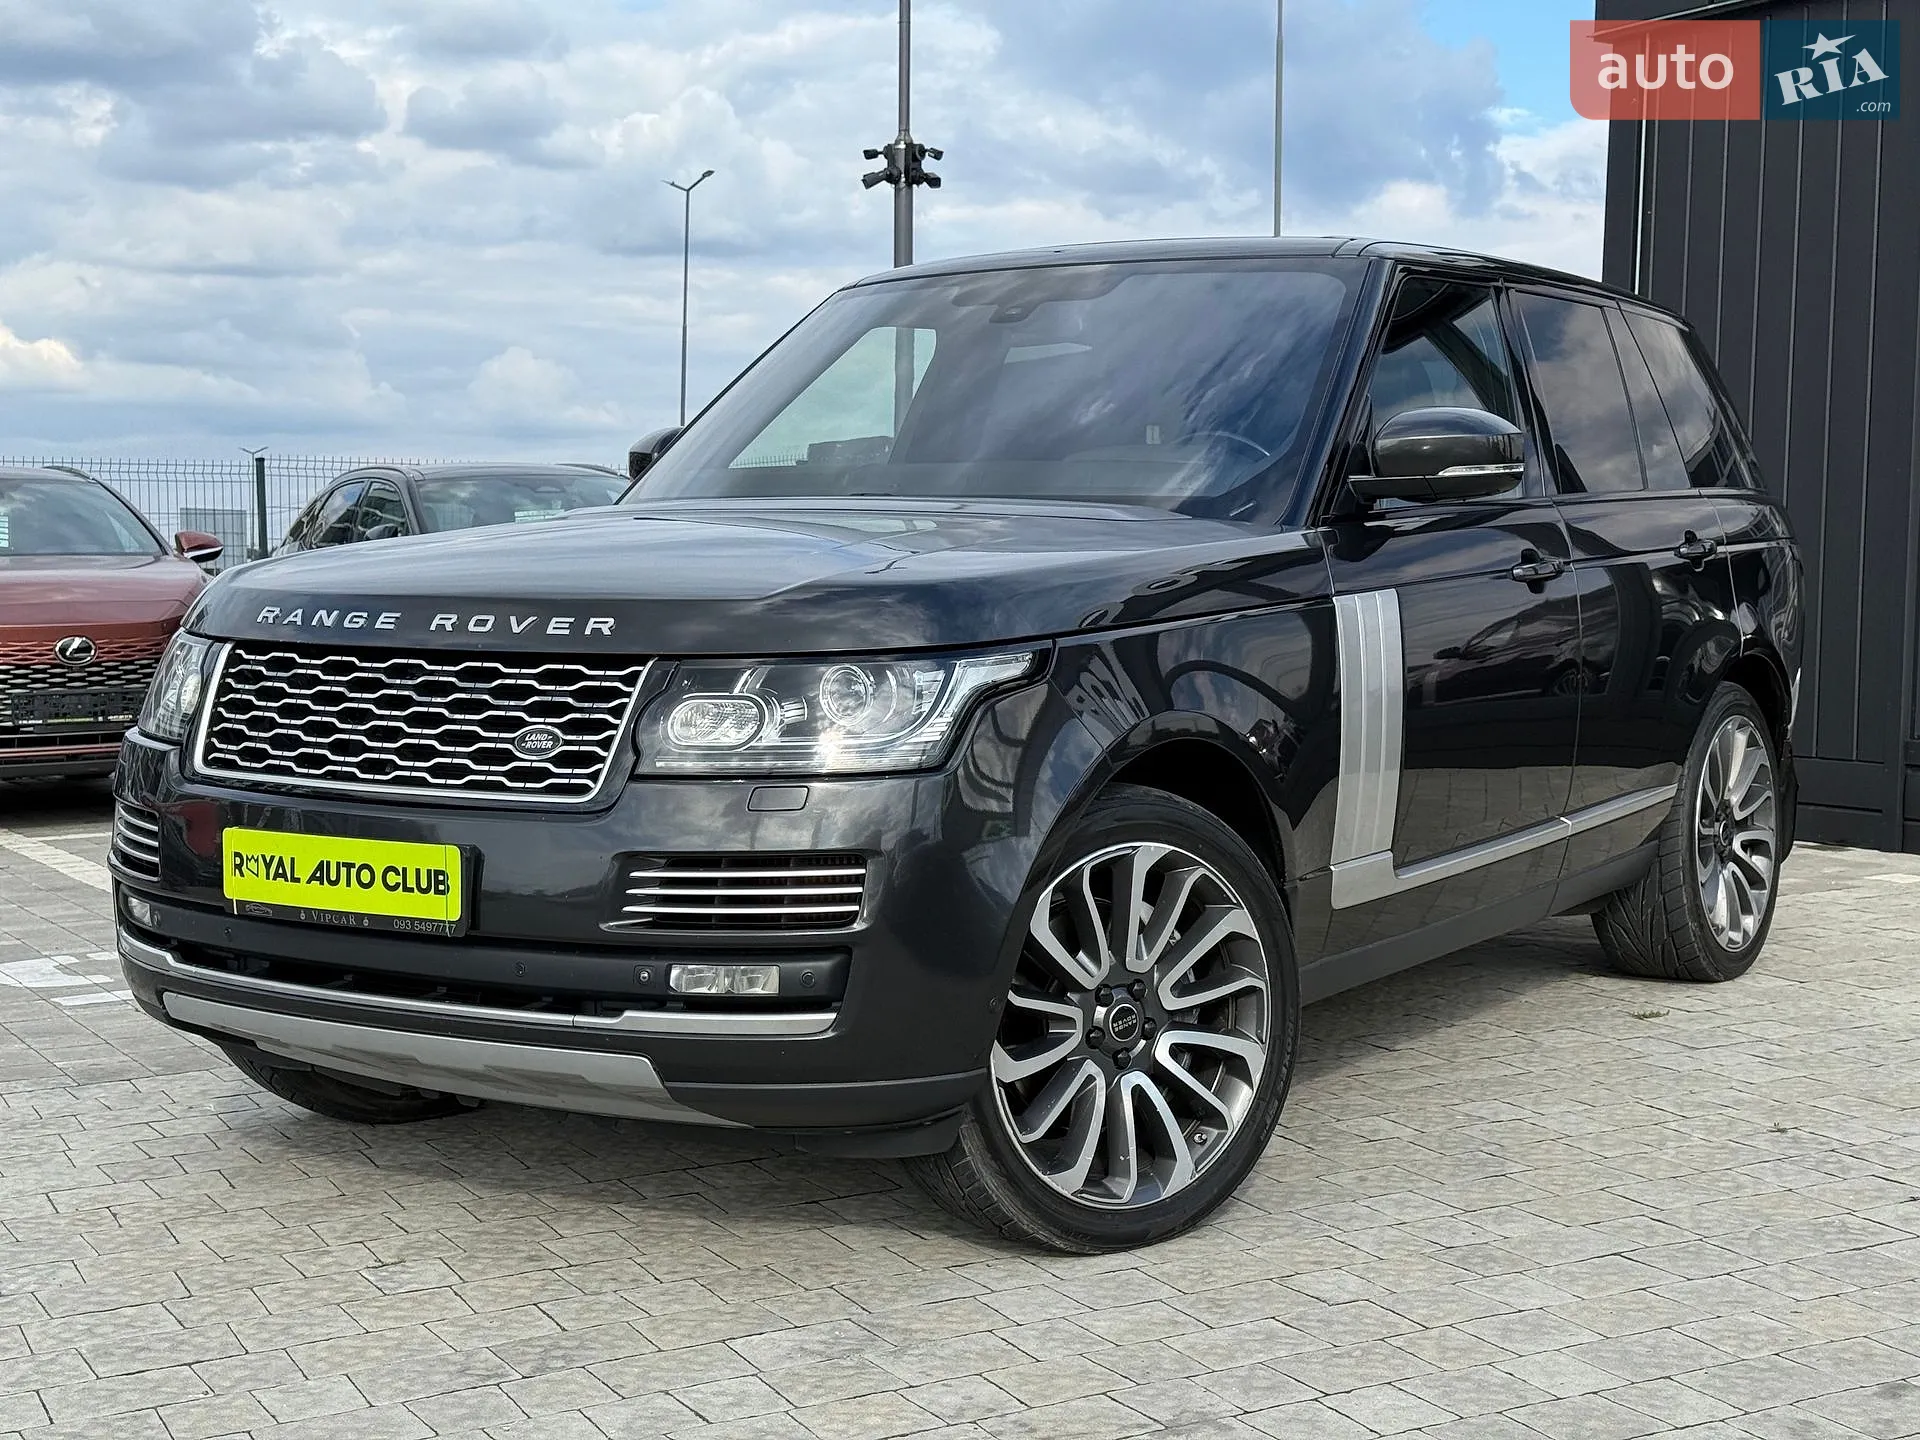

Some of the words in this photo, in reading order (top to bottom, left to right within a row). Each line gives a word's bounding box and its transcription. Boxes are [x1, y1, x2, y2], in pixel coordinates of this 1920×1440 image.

[256, 606, 401, 631] RANGE
[429, 613, 615, 636] ROVER
[305, 859, 376, 890] AUTO
[381, 865, 451, 896] CLUB
[393, 918, 412, 930] 093
